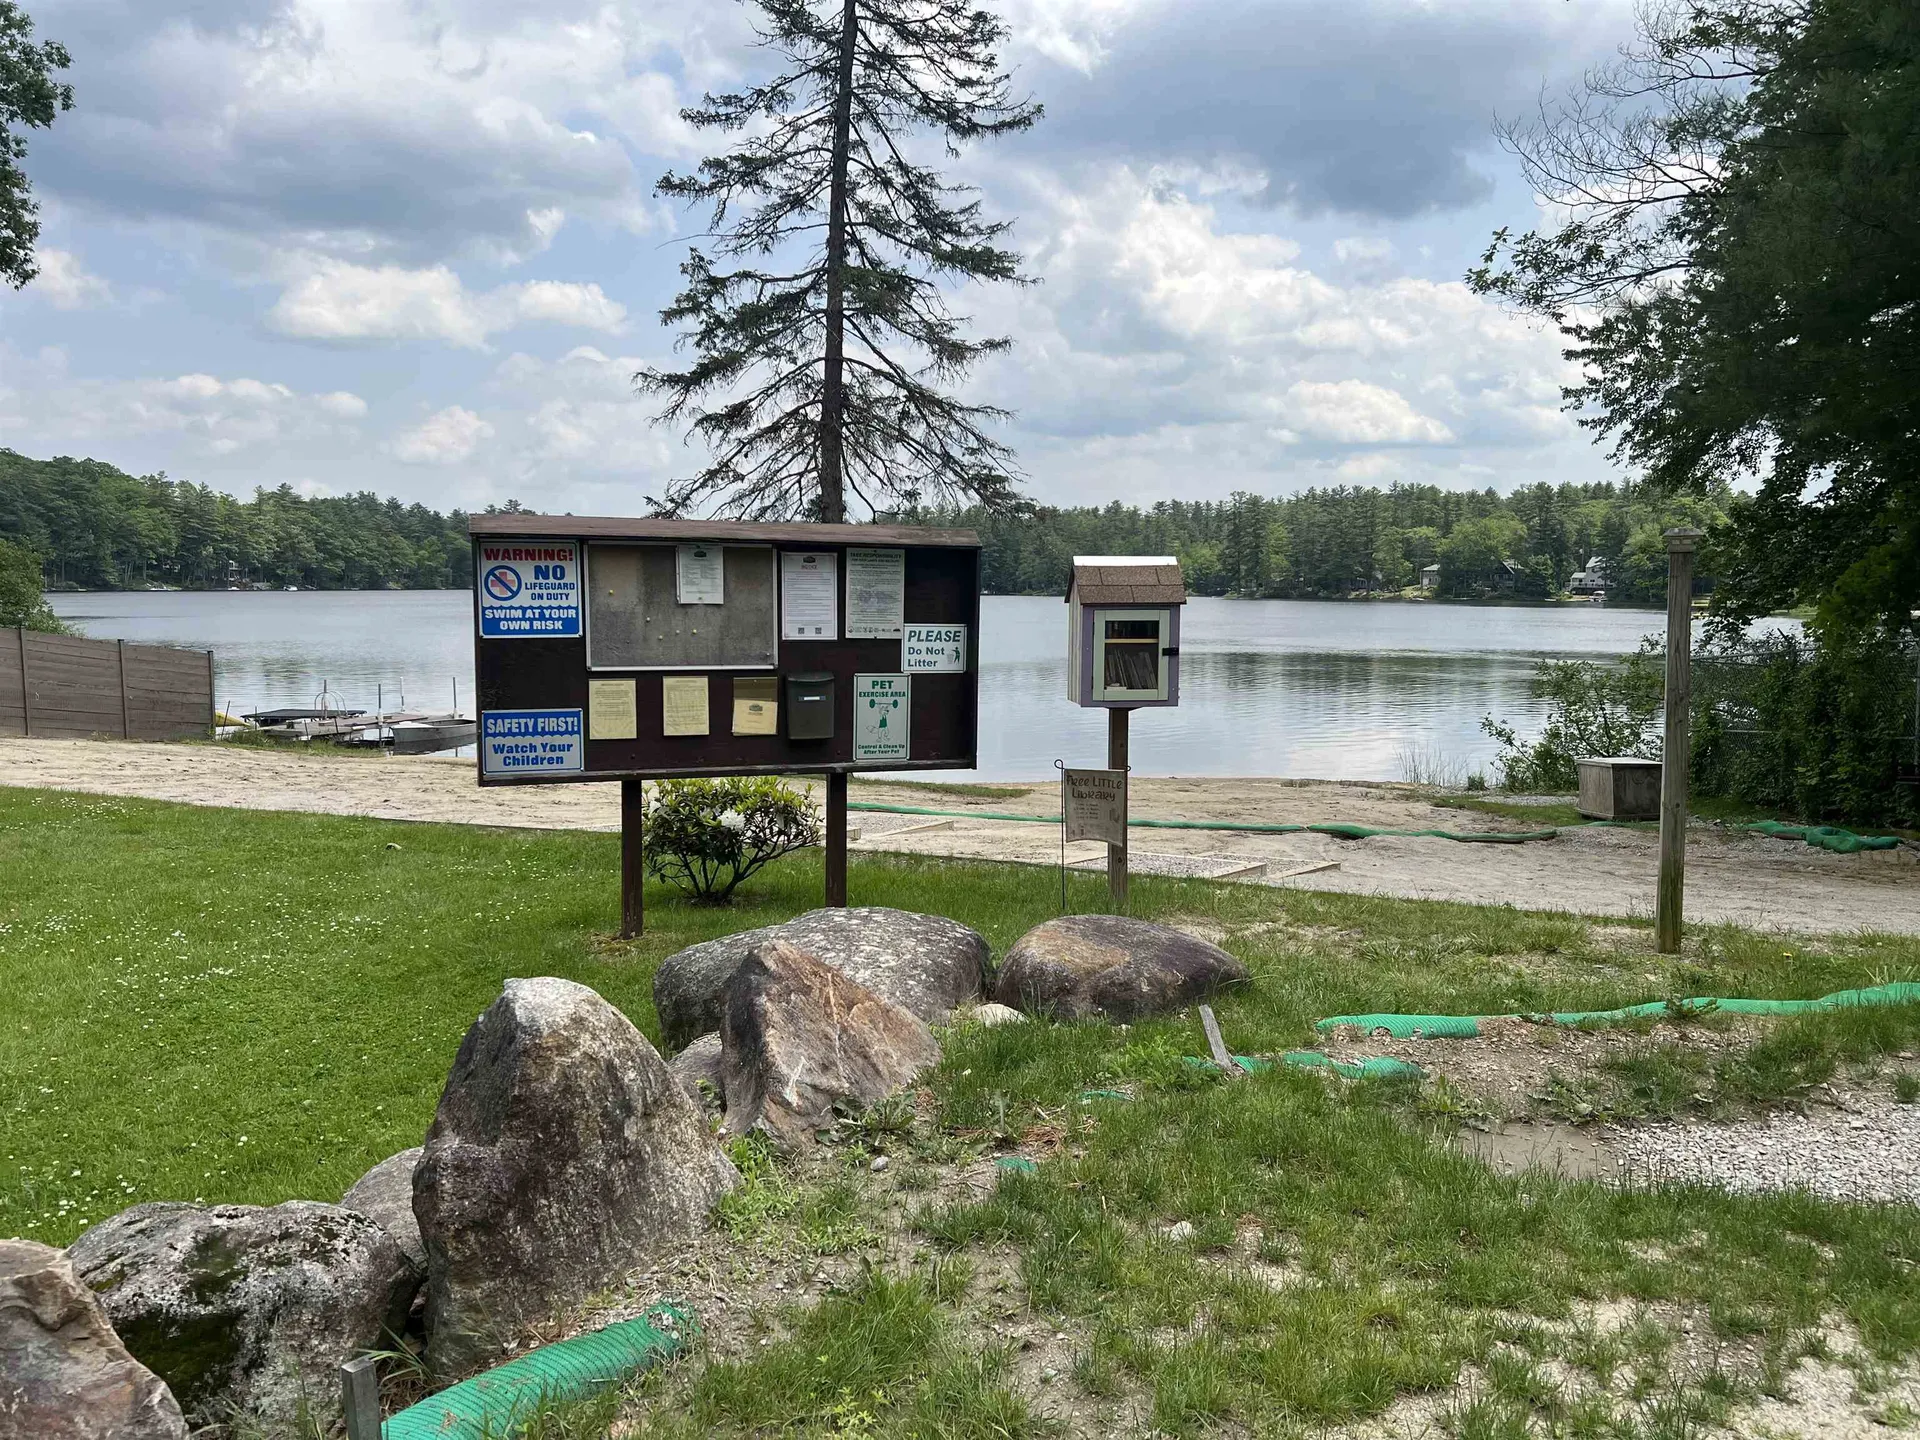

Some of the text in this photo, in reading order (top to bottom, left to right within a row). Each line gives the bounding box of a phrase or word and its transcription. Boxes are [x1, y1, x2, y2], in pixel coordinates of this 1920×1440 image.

[484, 548, 573, 561] WARNING!
[534, 565, 565, 580] NO
[525, 582, 575, 590] LIFEGUARD
[531, 592, 570, 601] ON DUTY
[485, 608, 576, 619] SWIM AT YOUR
[500, 620, 563, 630] OWN RISK
[908, 630, 961, 642] PLEASE
[908, 646, 945, 656] Do Not
[908, 658, 938, 668] Litter
[871, 681, 894, 690] PET
[486, 716, 578, 734] SAFETY FIRST!
[492, 742, 573, 755] Watch Your
[503, 755, 564, 767] Children
